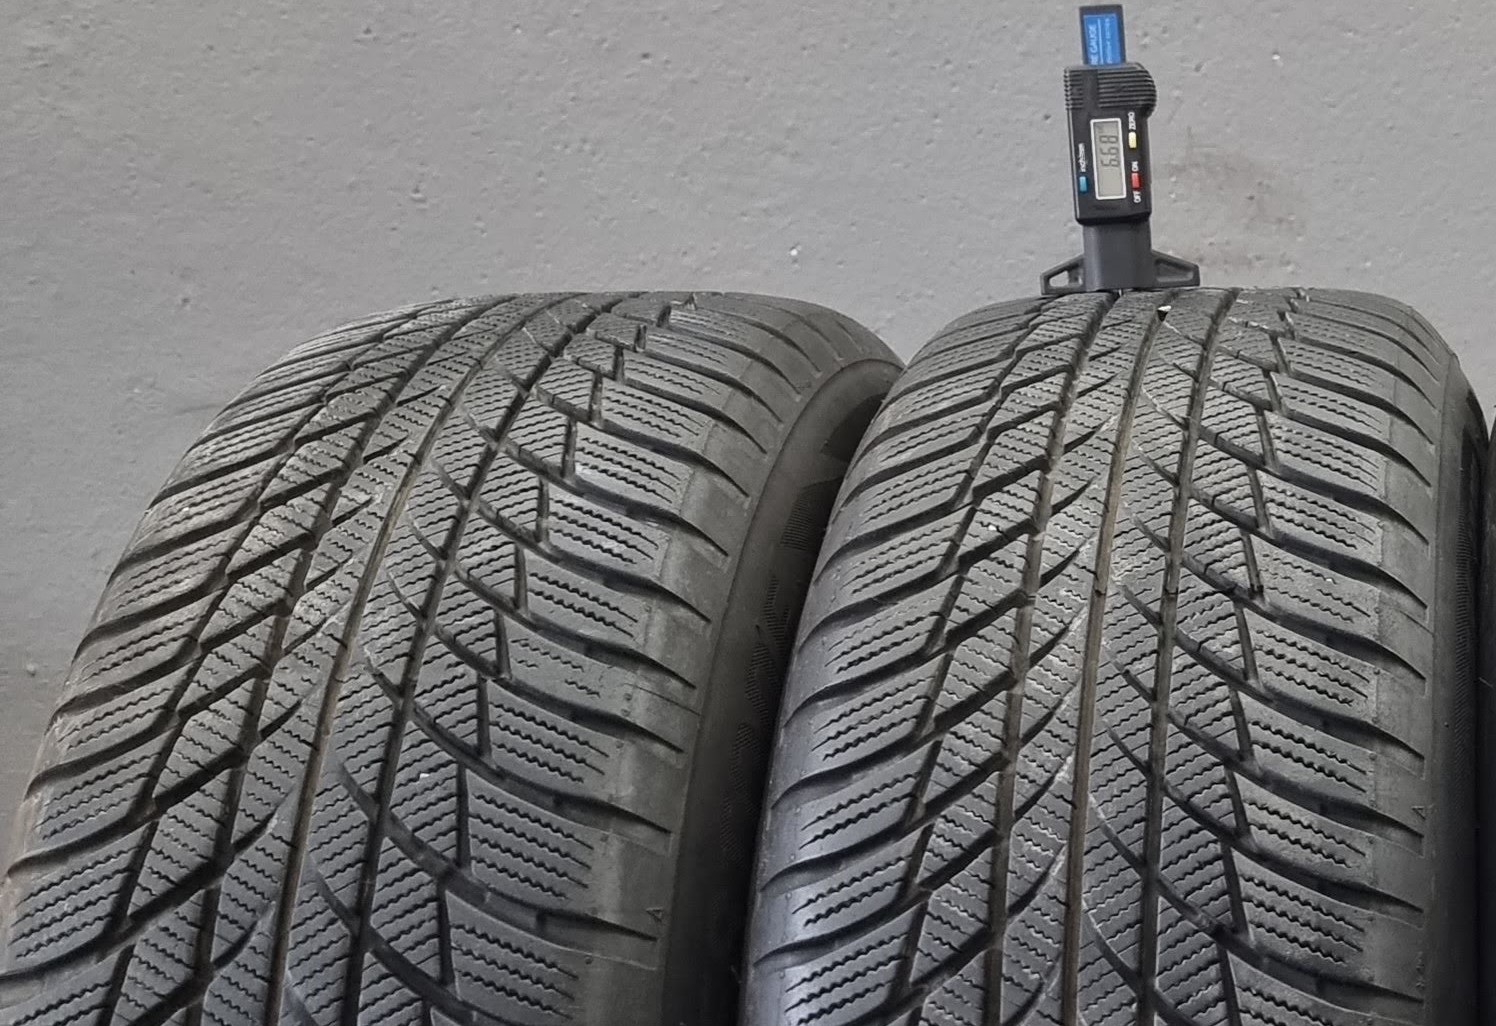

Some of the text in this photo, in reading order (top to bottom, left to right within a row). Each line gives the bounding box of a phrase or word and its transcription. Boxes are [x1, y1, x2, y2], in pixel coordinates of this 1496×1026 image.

[1089, 25, 1097, 53] GAUGE
[1128, 111, 1136, 130] ZERO
[1100, 135, 1119, 168] 6.68
[1131, 161, 1138, 171] ON
[1133, 191, 1141, 203] OFF
